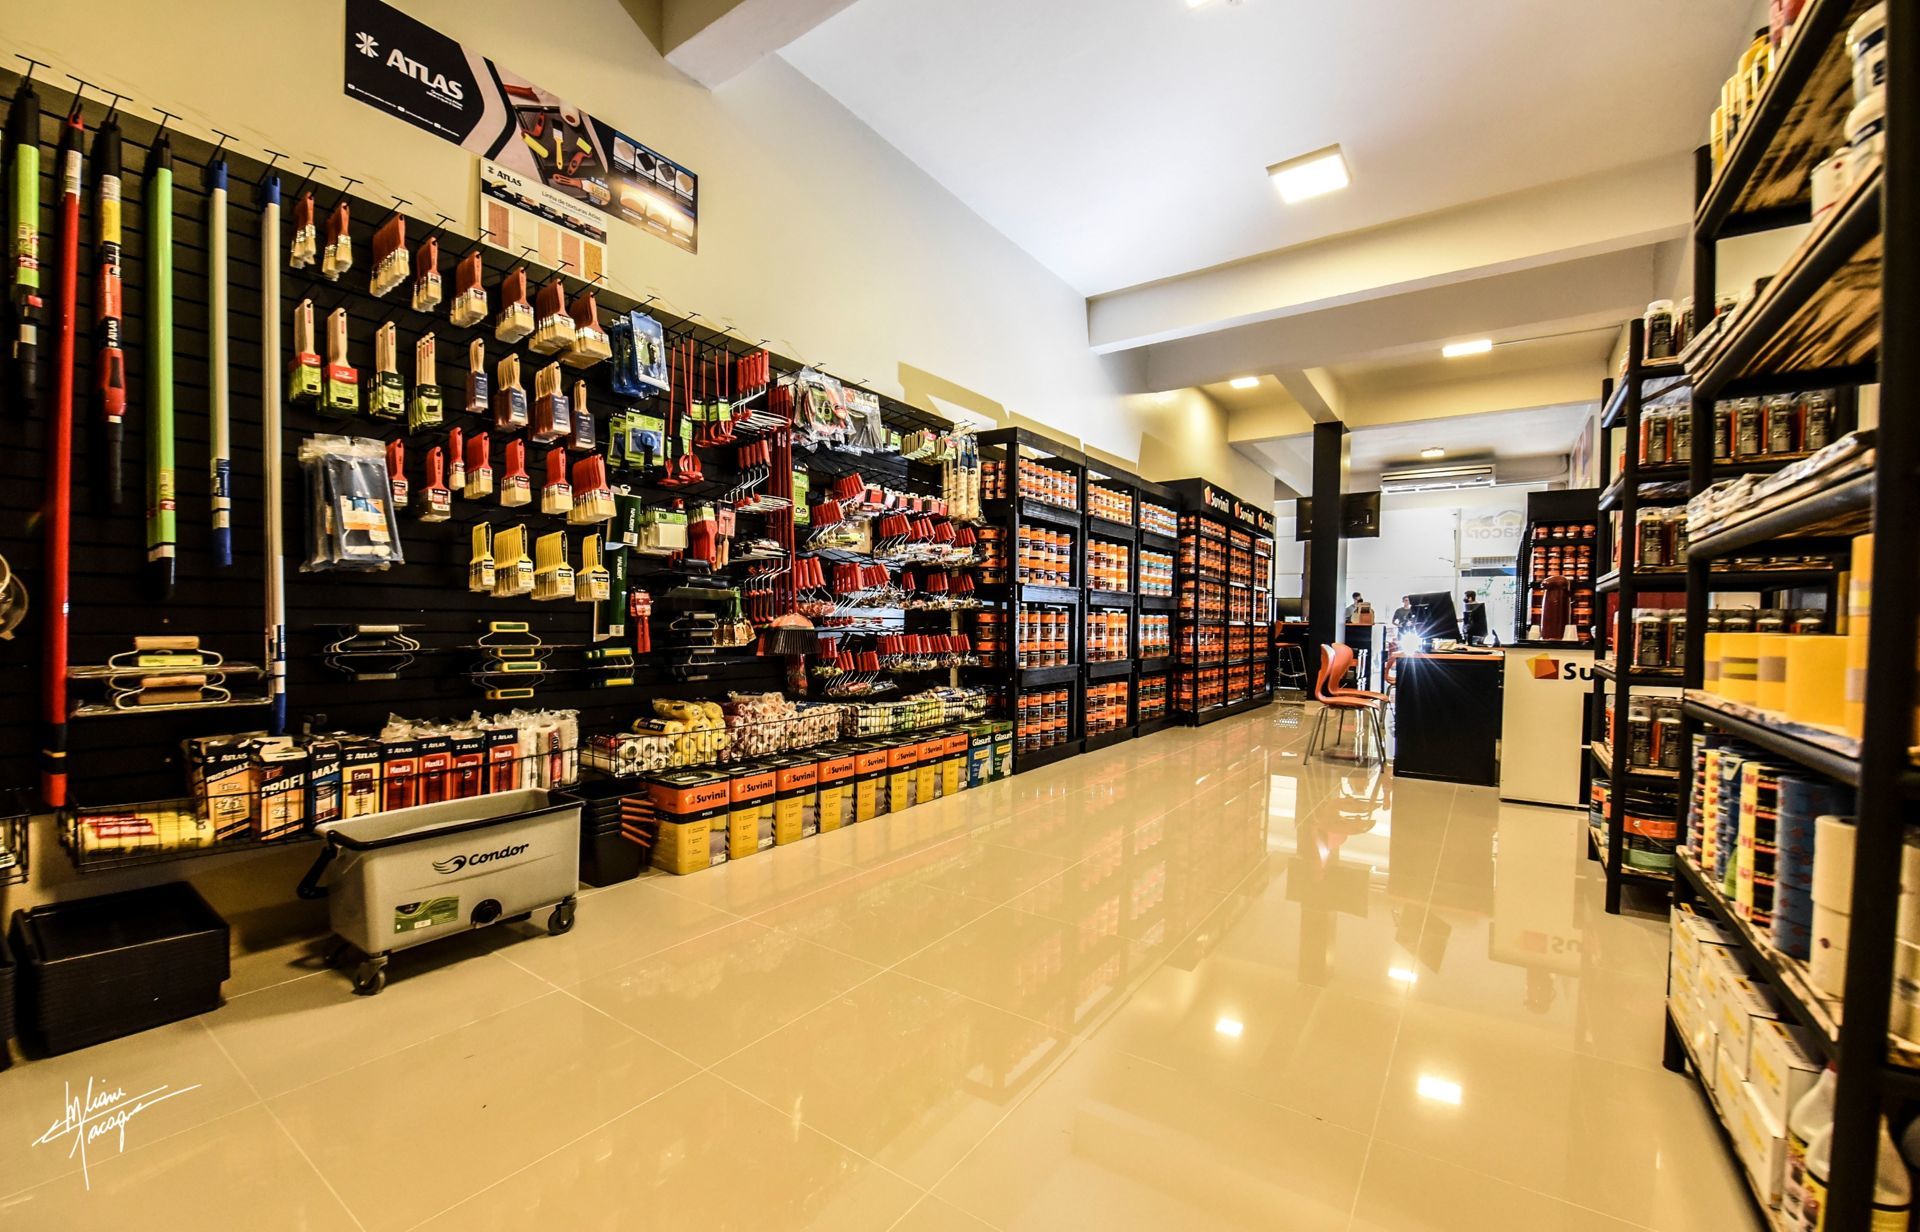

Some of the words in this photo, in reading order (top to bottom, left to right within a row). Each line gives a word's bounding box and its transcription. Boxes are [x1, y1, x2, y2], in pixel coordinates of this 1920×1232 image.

[386, 48, 464, 101] ATLAS
[497, 170, 522, 187] ATLAS
[107, 320, 118, 340] ATLAS
[1211, 492, 1230, 514] Suvinil
[1239, 506, 1255, 525] Suvinil
[498, 733, 514, 741] ATLAS
[972, 735, 992, 747] Glasurit
[994, 730, 1013, 742] Glasurit
[394, 746, 413, 754] ATLAS
[428, 741, 446, 749] ATLAS
[927, 744, 943, 754] Suvinil
[220, 752, 248, 762] ATLAS
[354, 751, 379, 760] ATLAS
[900, 749, 917, 760] Suvinil
[867, 756, 886, 767] Suvinil
[206, 760, 250, 783] PROFIMAX
[311, 761, 341, 780] MAX
[831, 763, 853, 774] Suvinil
[353, 771, 371, 780] Extra
[792, 769, 816, 782] Suvinil
[747, 779, 773, 792] Suvinil
[696, 789, 727, 804] Suvinil
